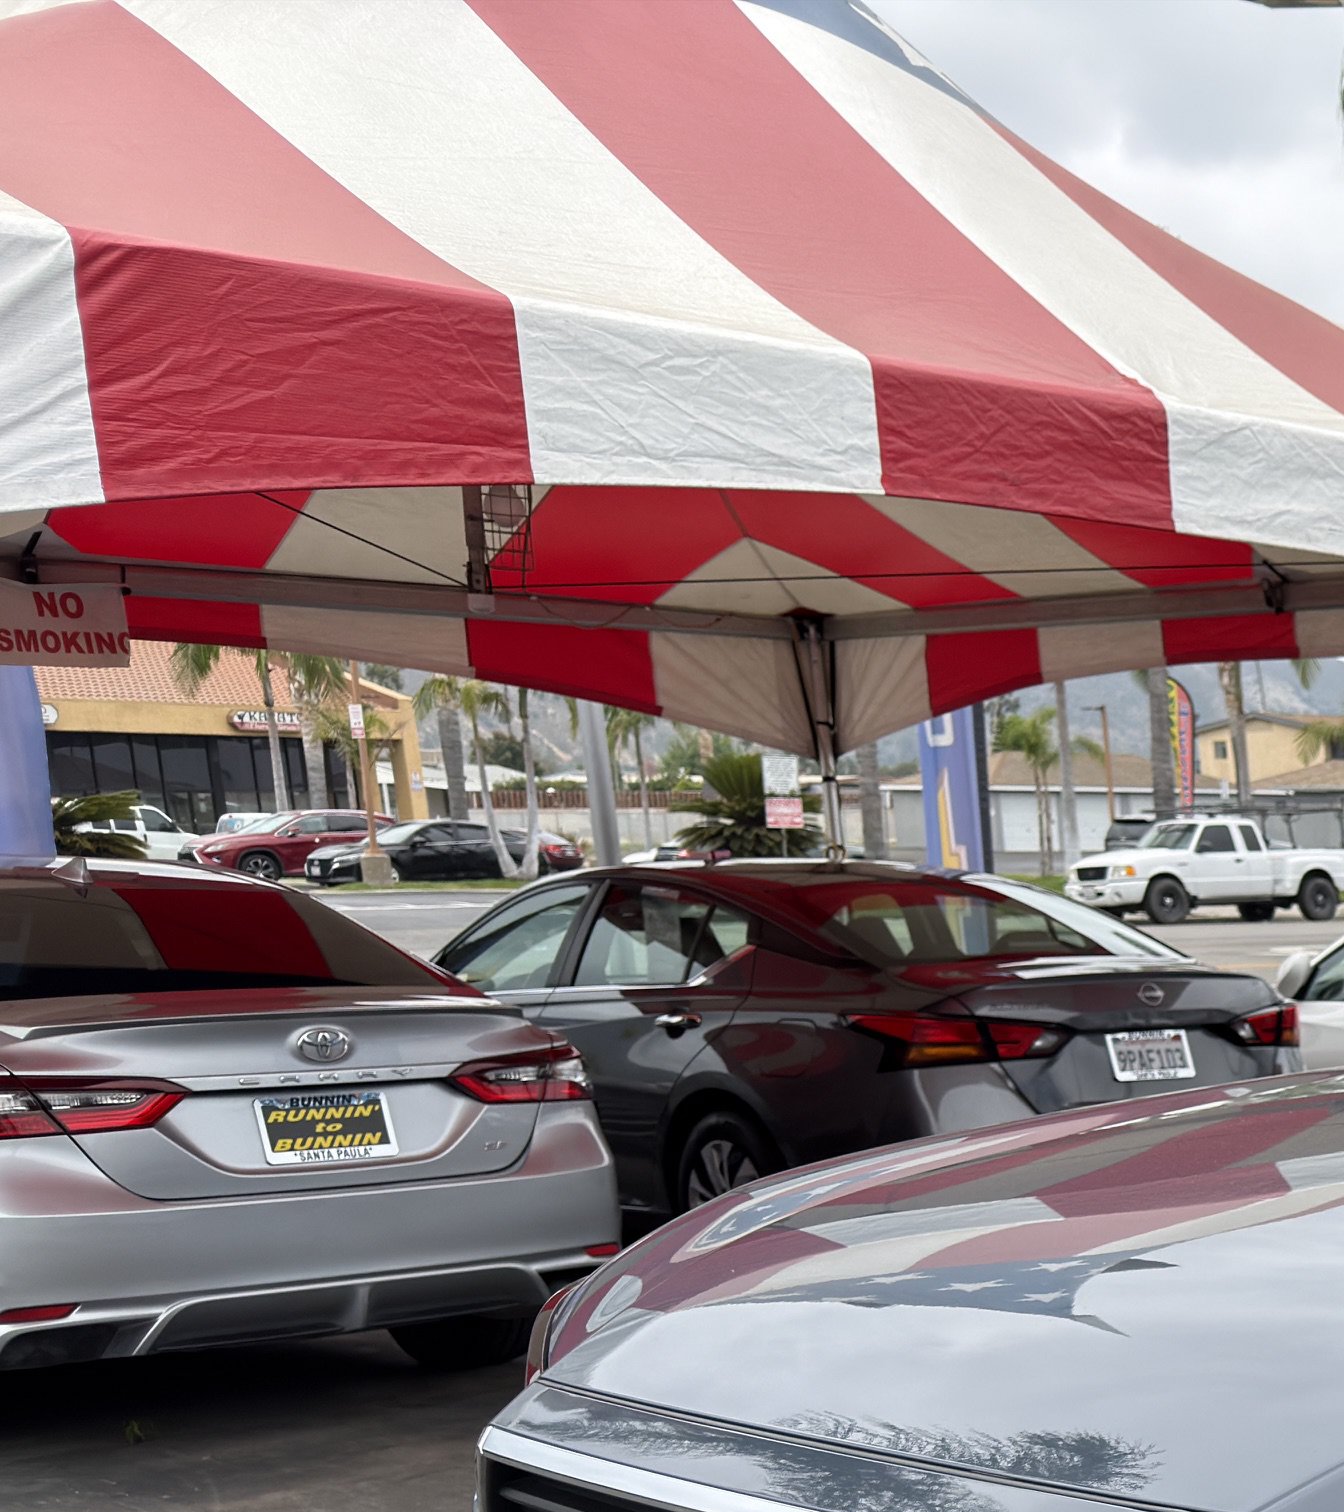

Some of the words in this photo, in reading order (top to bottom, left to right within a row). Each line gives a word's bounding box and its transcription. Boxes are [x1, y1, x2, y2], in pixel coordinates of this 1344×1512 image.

[33, 591, 84, 619] NO
[290, 1095, 352, 1108] BUNNIN
[267, 1105, 380, 1123] RUNNIN'
[315, 1122, 343, 1132] to
[274, 1132, 382, 1152] BUNNIN
[299, 1149, 333, 1162] SANTA
[337, 1148, 371, 1160] PAULA
